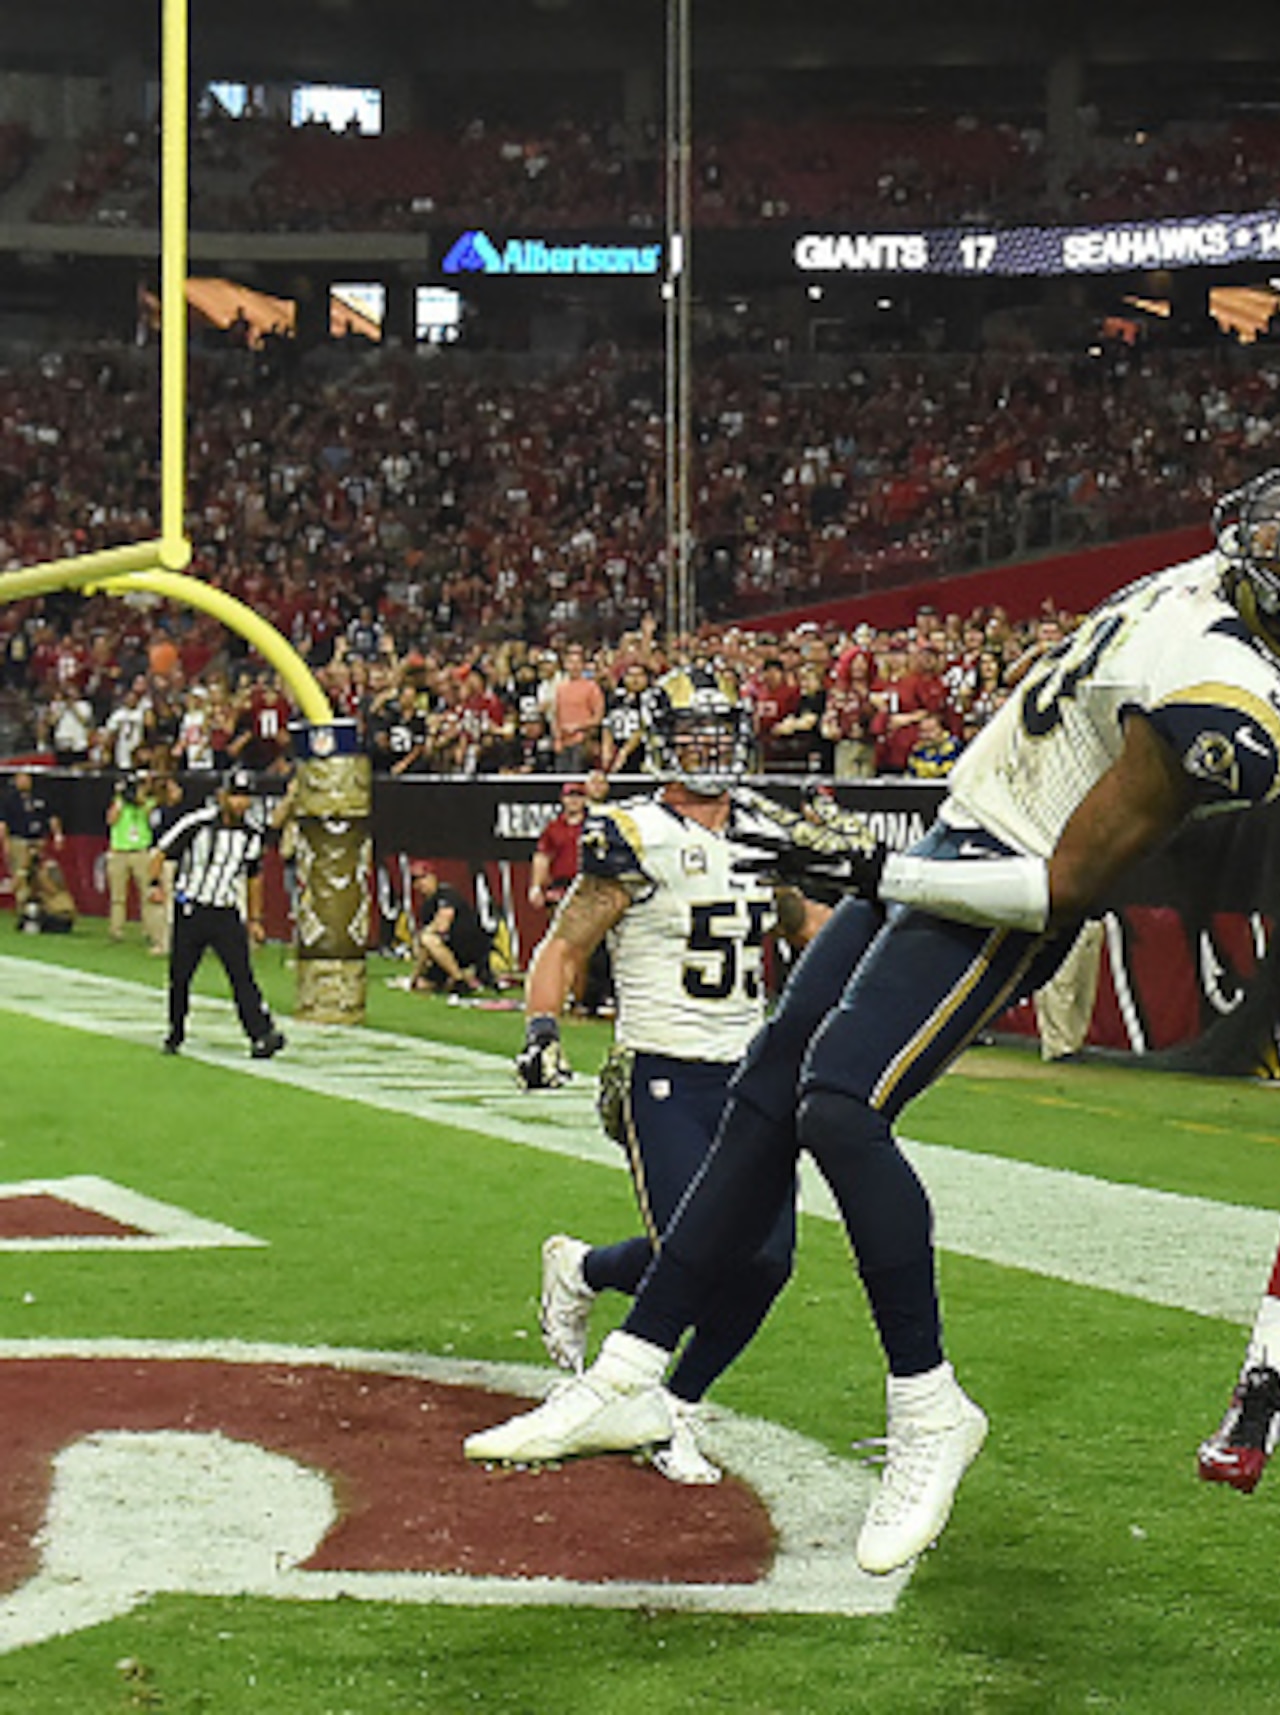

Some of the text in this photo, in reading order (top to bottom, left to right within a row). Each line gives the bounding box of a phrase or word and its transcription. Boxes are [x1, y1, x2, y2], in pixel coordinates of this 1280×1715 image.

[795, 235, 928, 269] GIANTS
[960, 235, 997, 269] 17
[1063, 223, 1229, 268] SEAHAWKS
